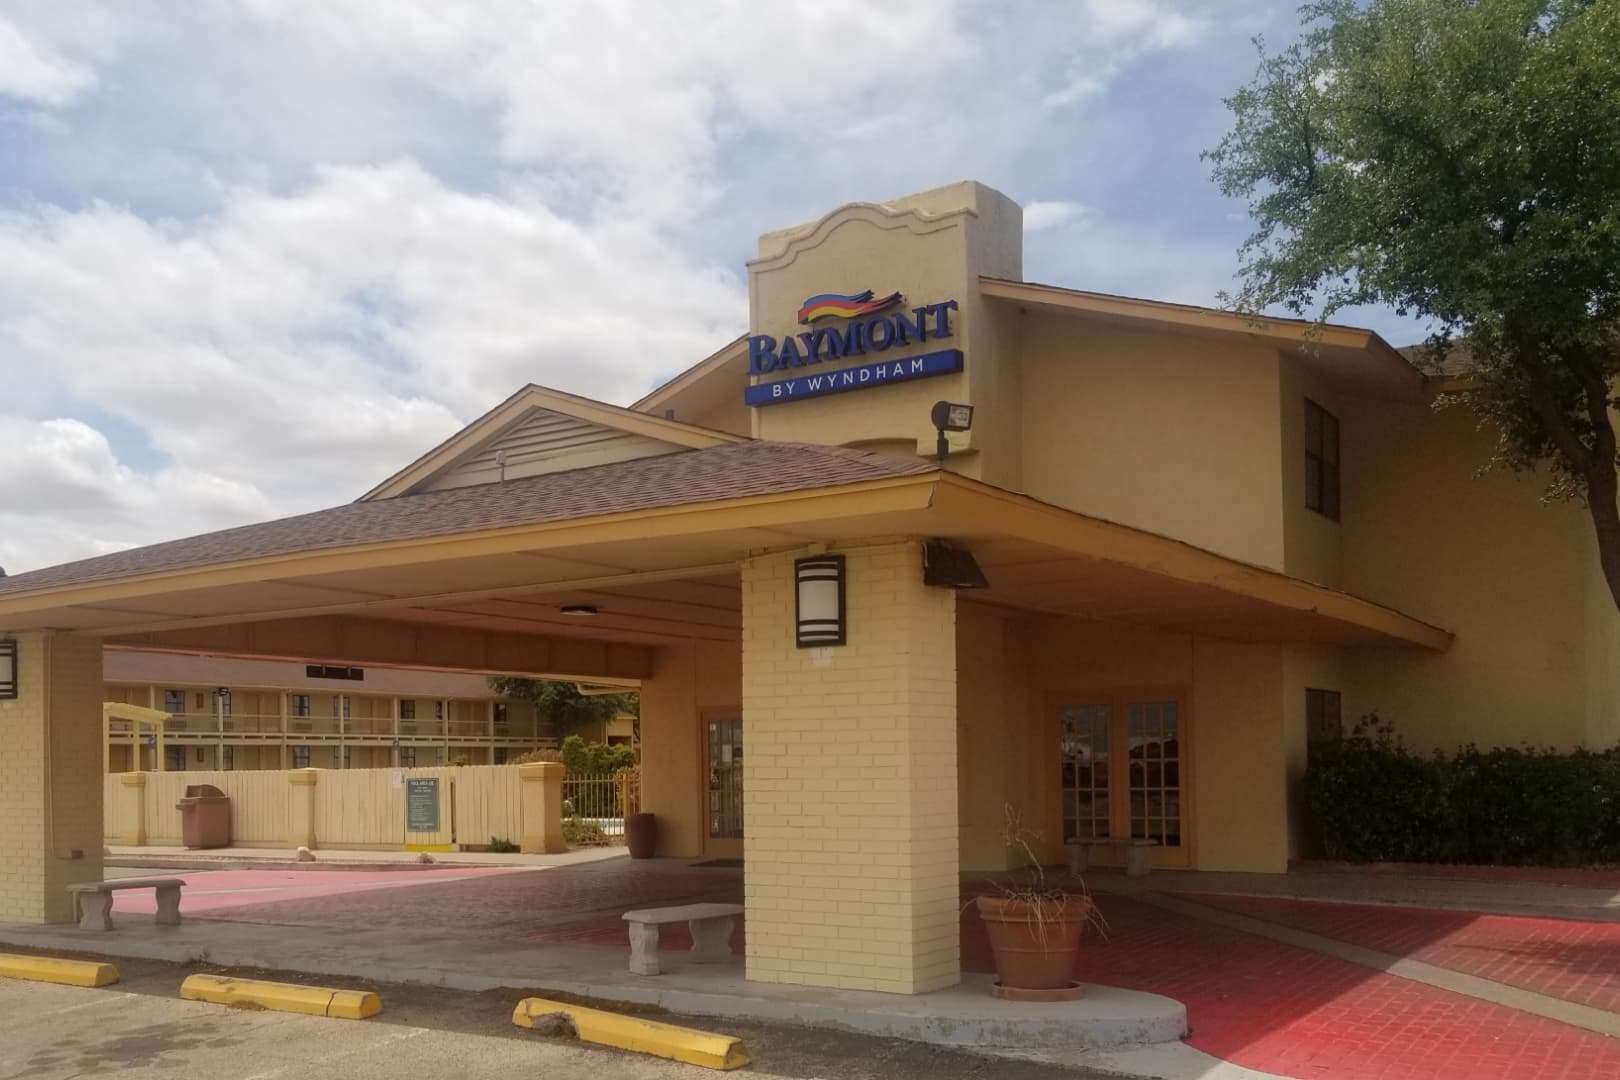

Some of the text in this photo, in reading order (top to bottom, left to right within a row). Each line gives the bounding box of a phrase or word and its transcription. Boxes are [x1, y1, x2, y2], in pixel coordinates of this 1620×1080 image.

[747, 300, 958, 375] BAYMONT
[772, 359, 923, 397] BY WYNDHAM
